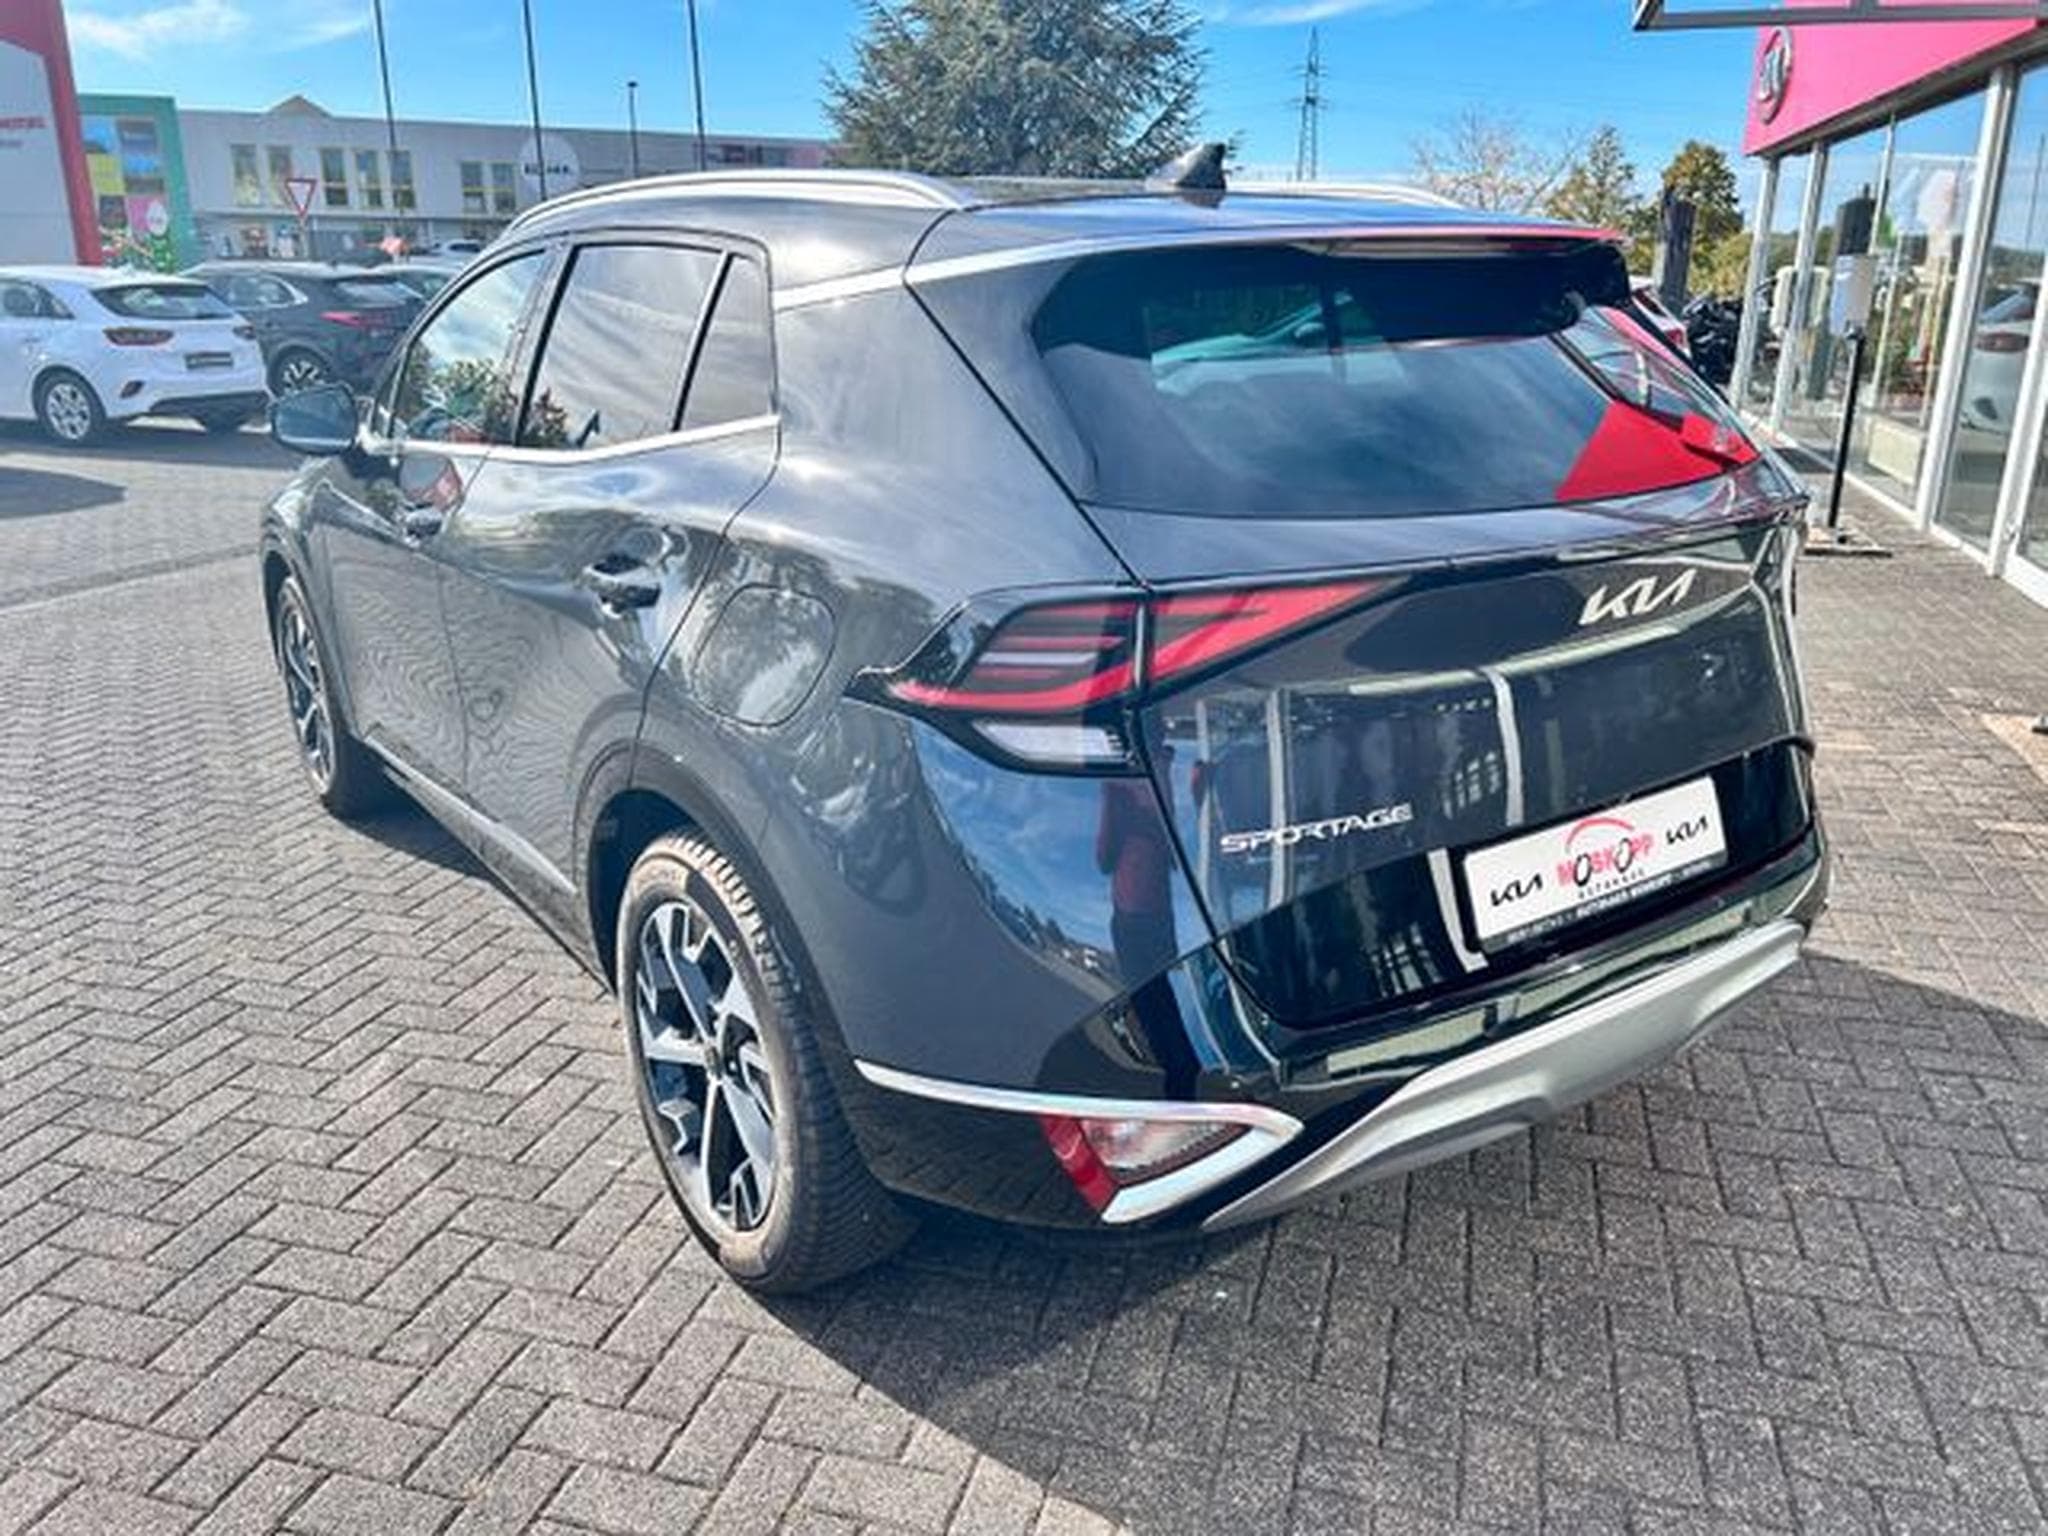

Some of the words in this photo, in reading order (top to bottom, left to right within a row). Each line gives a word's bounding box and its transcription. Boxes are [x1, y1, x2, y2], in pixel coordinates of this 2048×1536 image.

[1578, 567, 1697, 626] KIA
[1220, 802, 1414, 853] SPORTAGE
[1665, 815, 1709, 845] KIA
[1490, 873, 1543, 906] KIA
